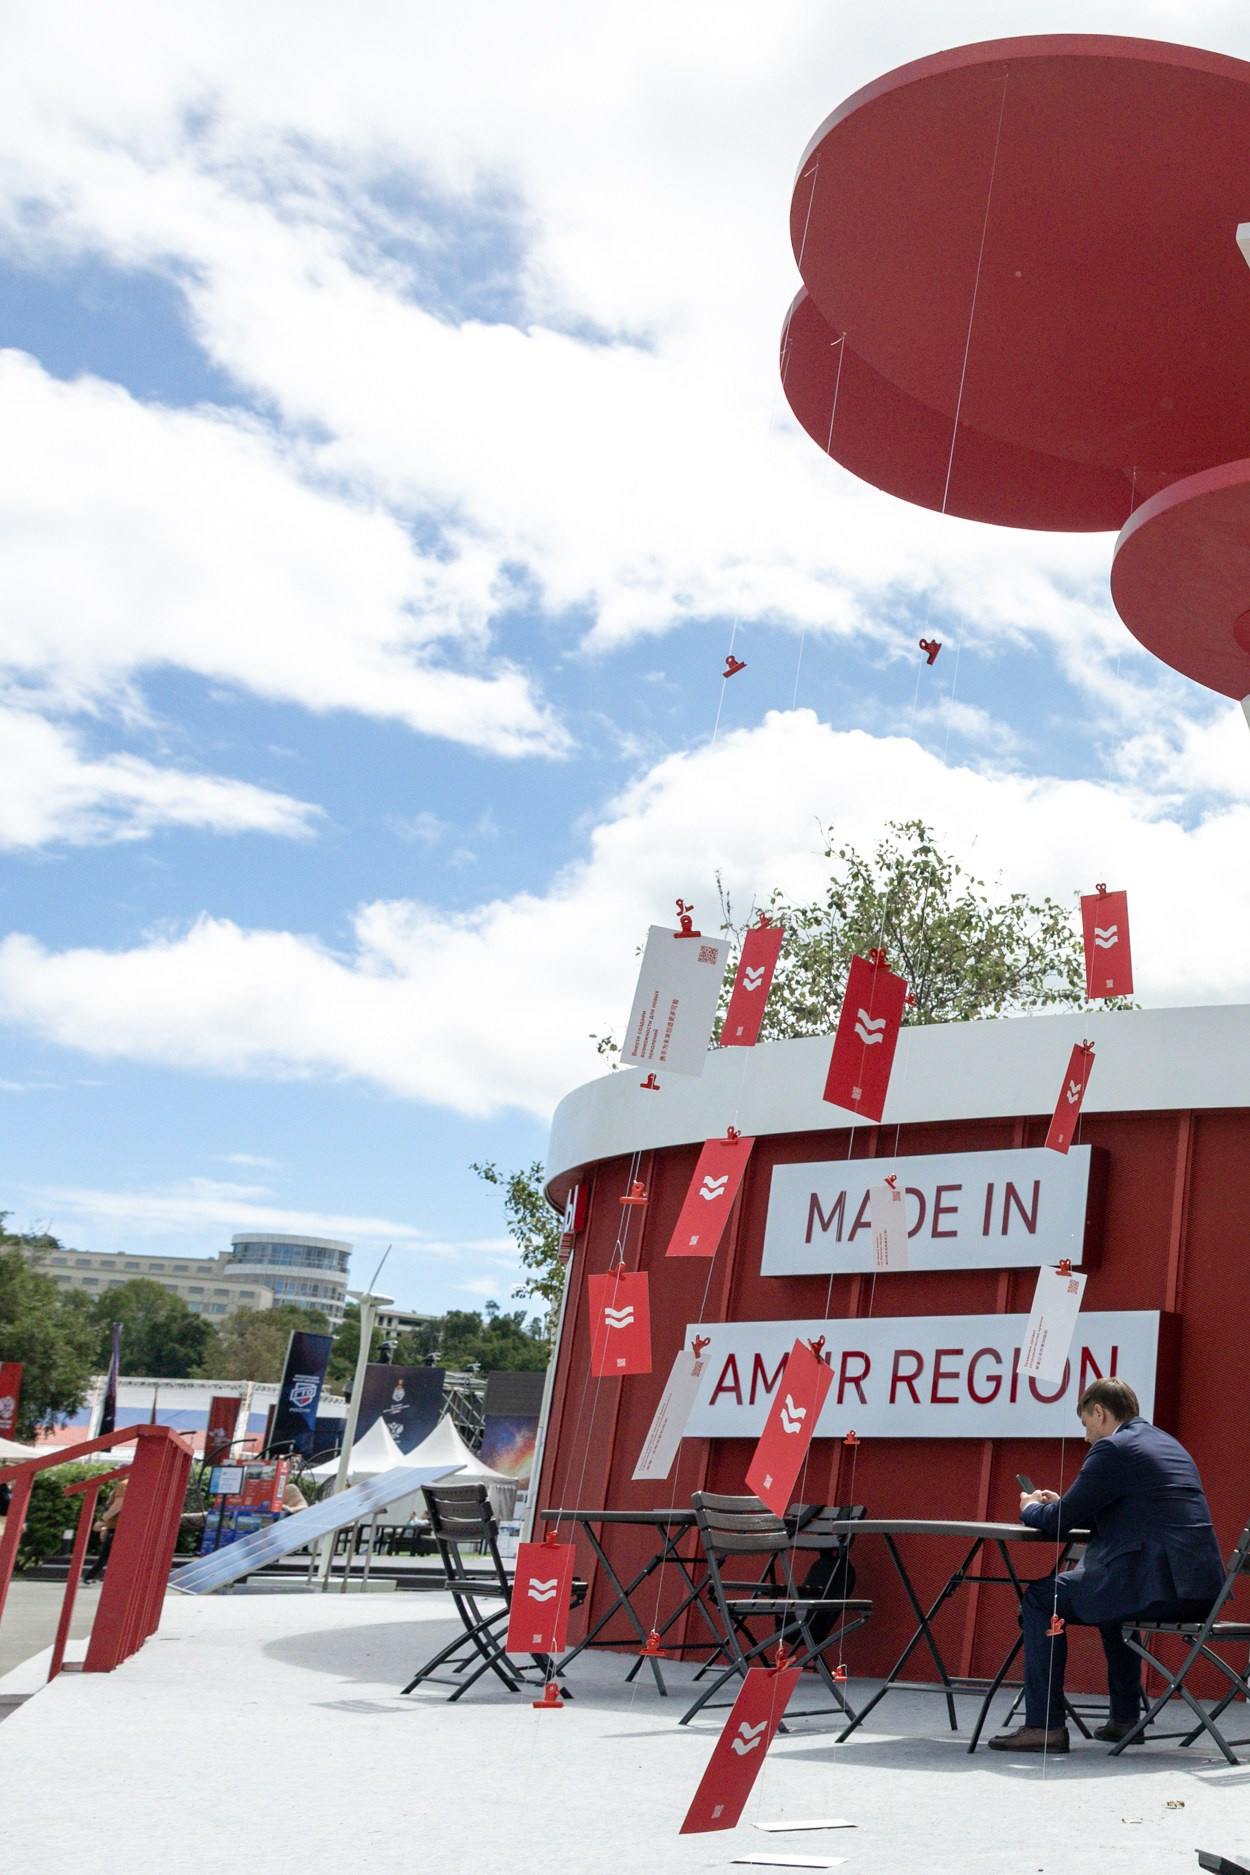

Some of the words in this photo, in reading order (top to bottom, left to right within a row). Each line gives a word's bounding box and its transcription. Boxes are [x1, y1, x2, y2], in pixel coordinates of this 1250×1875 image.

[632, 1036, 641, 1057] Вместе
[982, 1179, 1041, 1237] IN
[708, 1350, 872, 1406] AMR
[889, 1345, 1119, 1405] REGION
